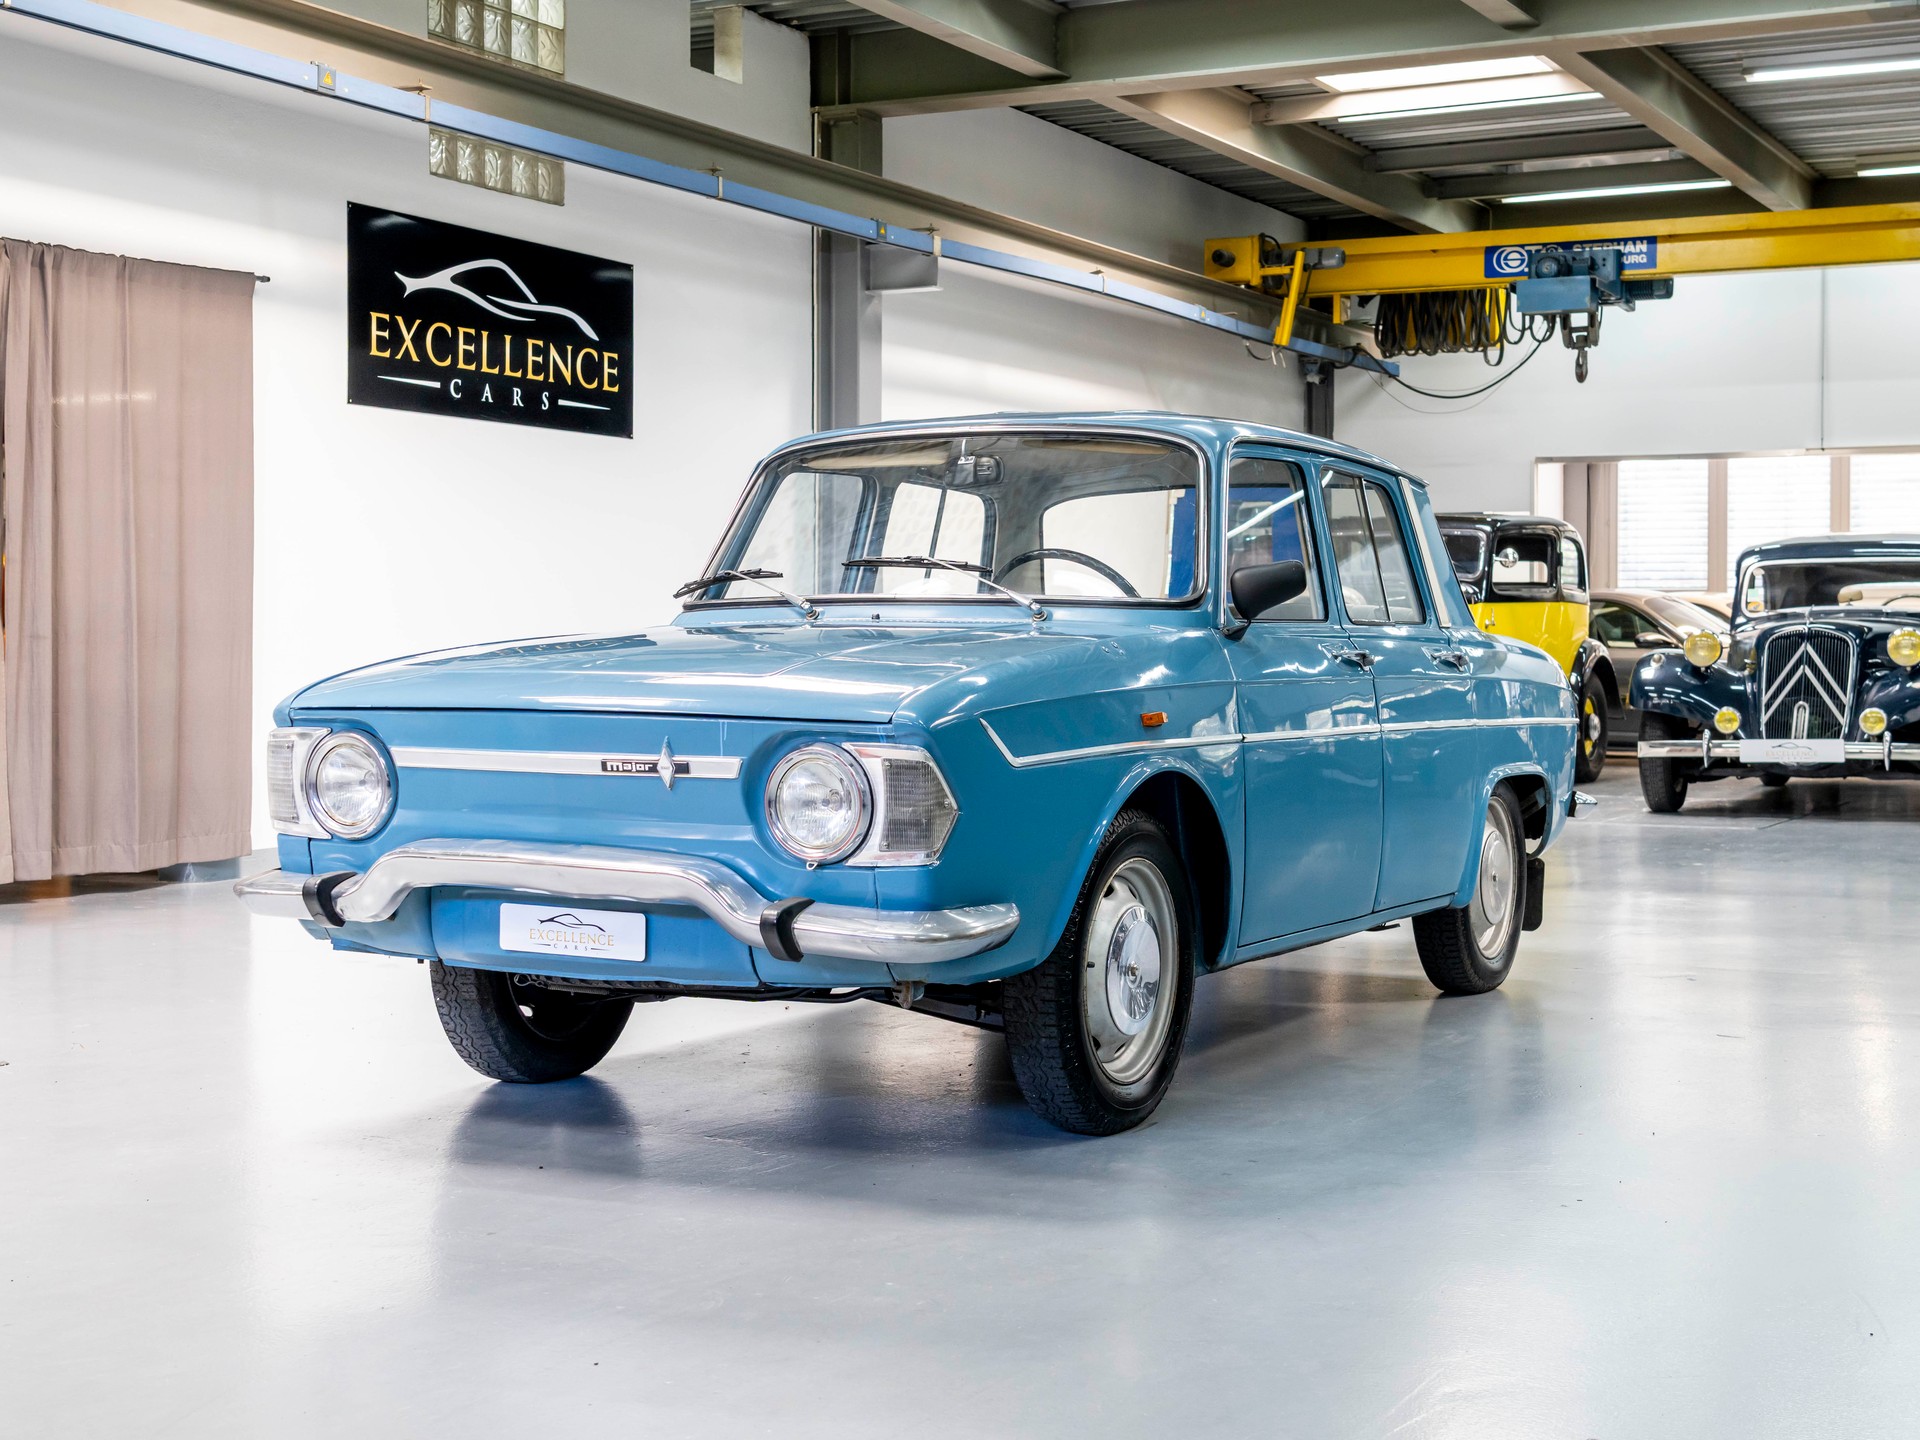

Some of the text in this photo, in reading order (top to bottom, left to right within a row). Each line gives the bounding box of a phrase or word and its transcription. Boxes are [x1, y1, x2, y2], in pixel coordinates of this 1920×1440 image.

[1621, 254, 1648, 264] URG
[369, 311, 620, 392] EXCELLENCE
[450, 379, 549, 410] CARS
[529, 928, 615, 946] EXCELLENCE
[553, 943, 588, 951] CARS
